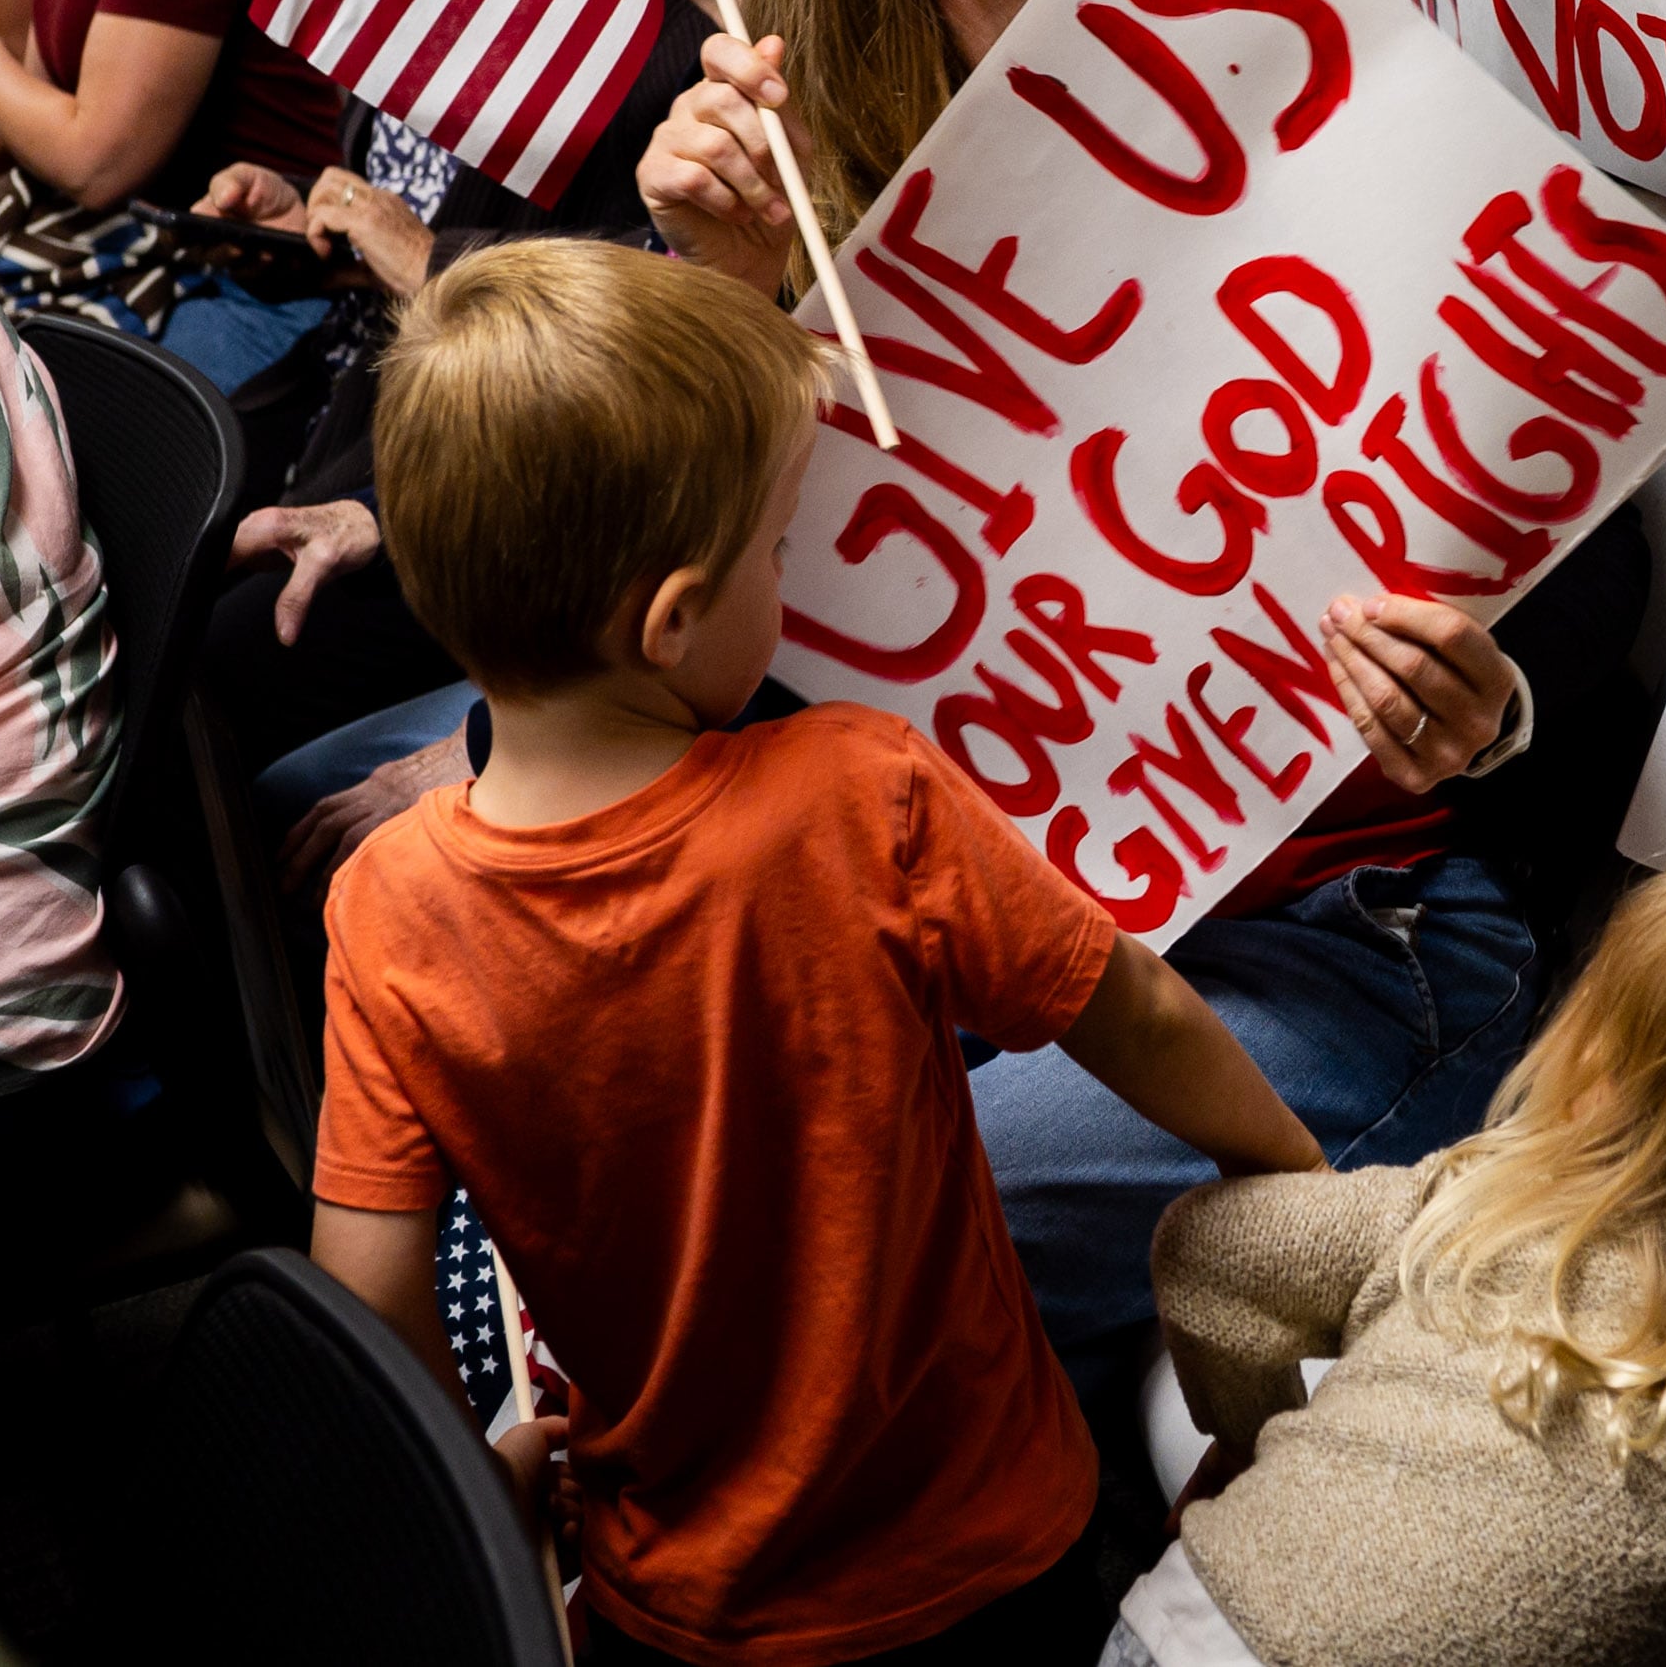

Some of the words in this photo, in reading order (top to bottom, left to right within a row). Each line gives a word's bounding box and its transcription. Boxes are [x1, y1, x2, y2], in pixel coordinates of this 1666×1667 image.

[779, 166, 1145, 686] GIVE
[933, 572, 1159, 818] OUR
[1068, 253, 1374, 598] GOD
[1044, 581, 1350, 935] GIVEN
